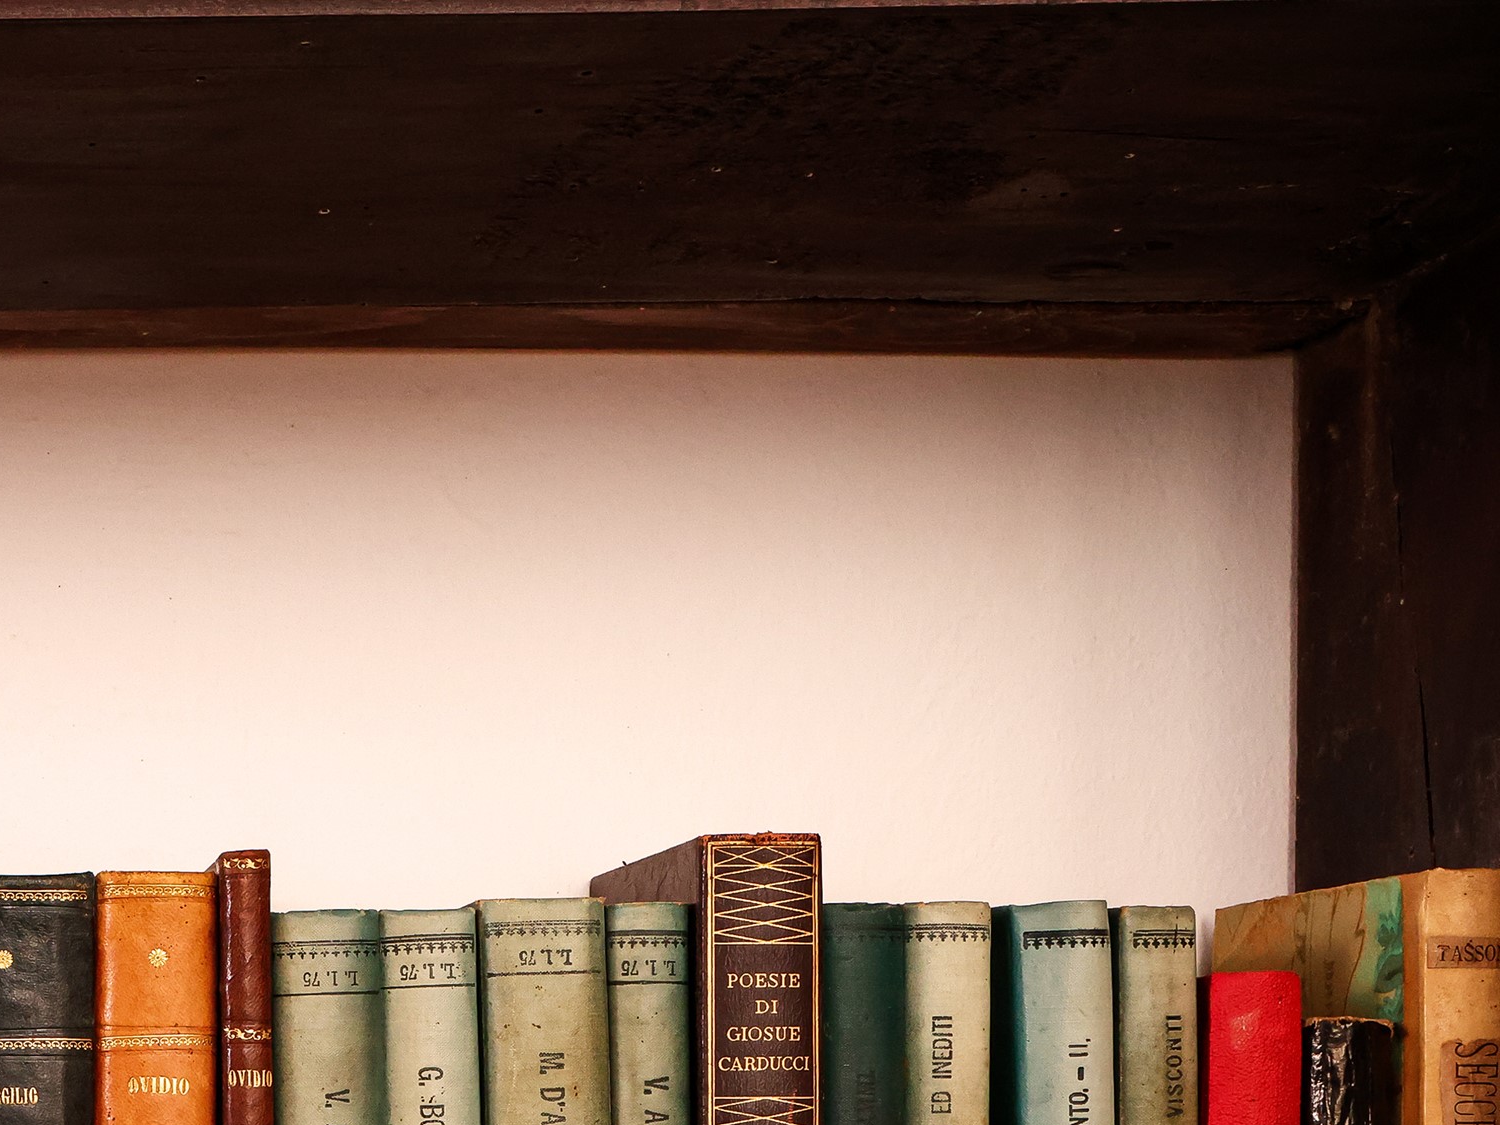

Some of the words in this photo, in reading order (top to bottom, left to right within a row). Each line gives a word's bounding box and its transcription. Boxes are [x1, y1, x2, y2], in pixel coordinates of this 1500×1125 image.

[518, 950, 536, 966] 75
[1437, 942, 1500, 962] TASSO
[400, 964, 419, 981] 75
[621, 960, 639, 976] 75
[663, 960, 677, 976] L.
[303, 971, 320, 987] 75
[344, 970, 359, 986] L.
[727, 973, 800, 988] POESIE
[755, 1000, 778, 1014] DI
[726, 1026, 800, 1042] GIOSUE
[932, 1015, 953, 1079] INEDITI
[539, 1052, 565, 1075] M.
[718, 1056, 809, 1071] CARDUCCI
[1165, 1014, 1184, 1118] VISCONTI
[228, 1069, 273, 1088] OVIDIO
[418, 1067, 444, 1086] G.
[643, 1076, 670, 1095] V.
[128, 1076, 190, 1096] OVIDIO
[325, 1089, 351, 1108] V.
[931, 1091, 952, 1114] ED
